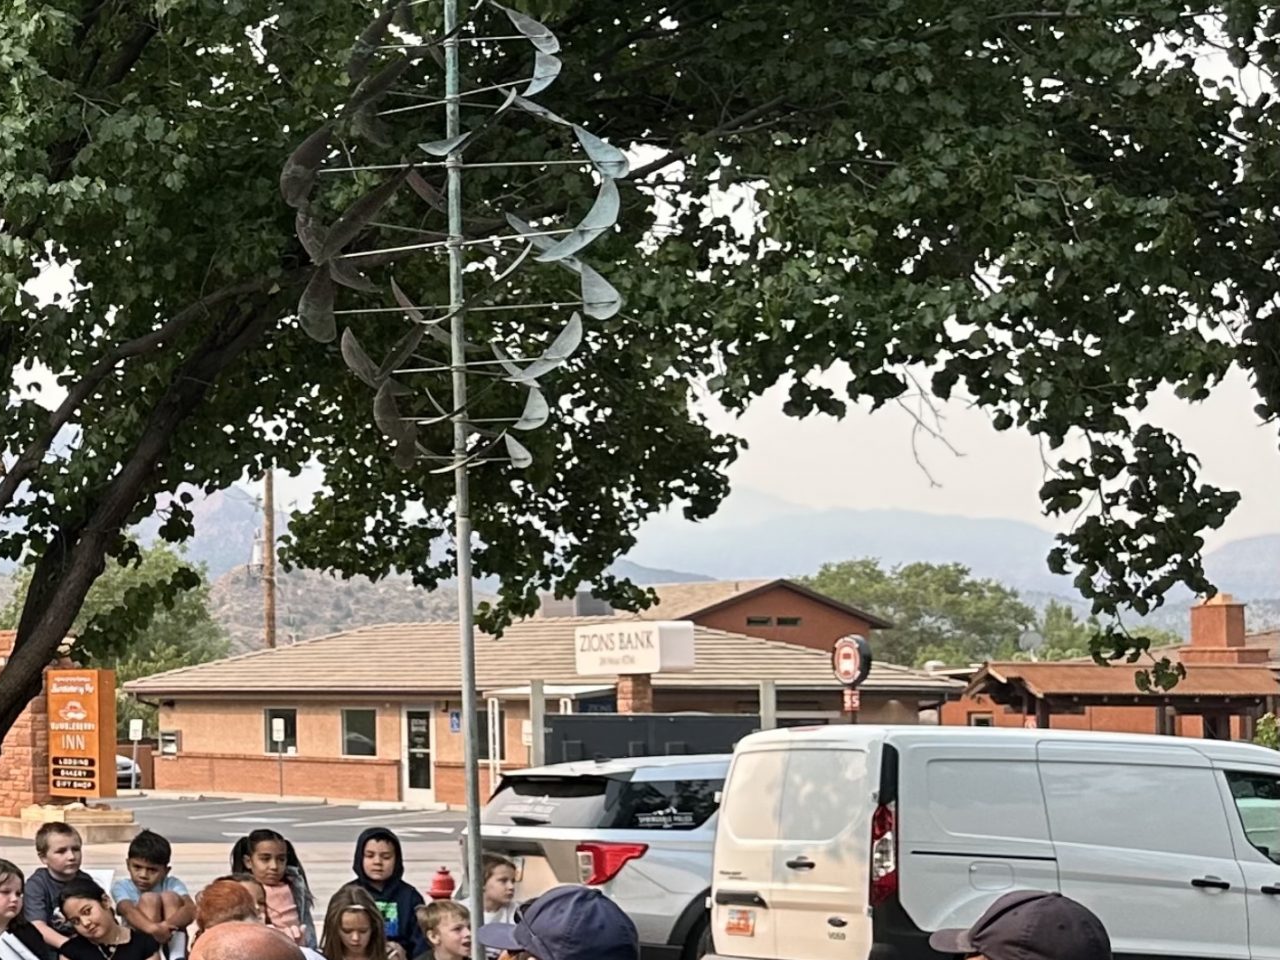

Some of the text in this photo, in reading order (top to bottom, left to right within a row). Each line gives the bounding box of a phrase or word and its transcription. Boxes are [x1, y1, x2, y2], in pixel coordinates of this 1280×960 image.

[580, 631, 654, 652] ZIONS BANK
[61, 734, 85, 750] INN
[58, 758, 89, 766] LODGING
[60, 769, 87, 777] BAKERY
[73, 781, 92, 789] SHOP
